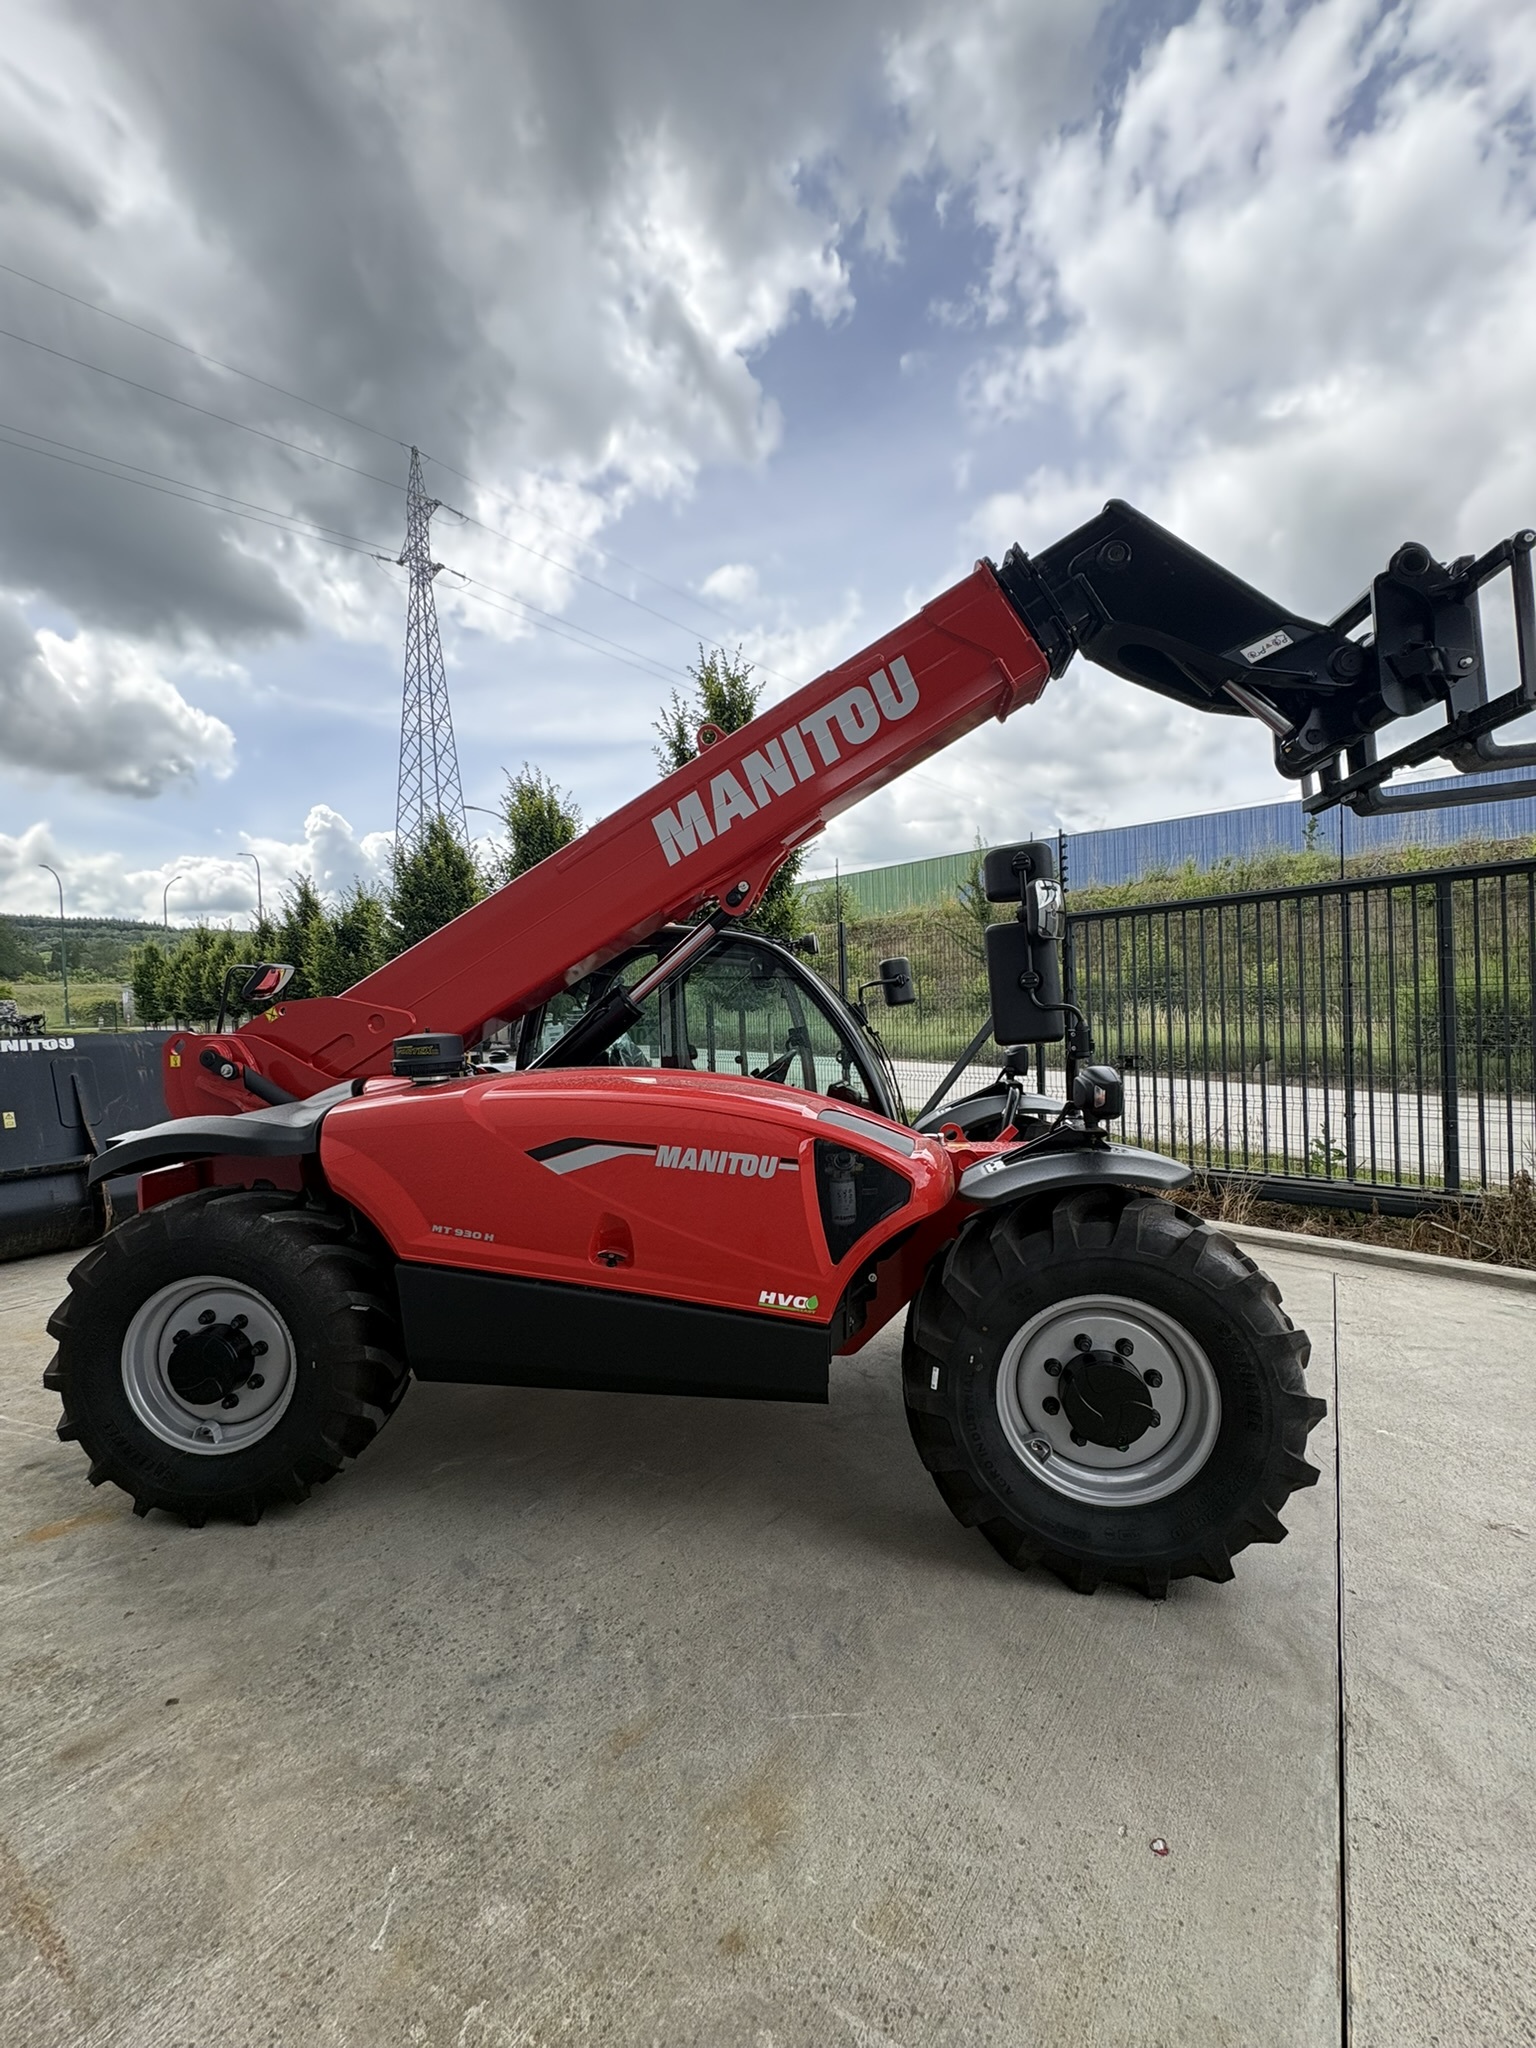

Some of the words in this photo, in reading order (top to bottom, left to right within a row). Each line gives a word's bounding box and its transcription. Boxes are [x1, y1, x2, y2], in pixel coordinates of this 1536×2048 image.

[651, 655, 920, 867] MANITOU
[0, 1037, 75, 1053] NITOU
[655, 1145, 779, 1179] MANITOU
[432, 1224, 452, 1235] MT
[454, 1228, 482, 1240] 930
[483, 1232, 495, 1242] H
[759, 1290, 809, 1309] HVO
[981, 1458, 1015, 1497] AGRO
